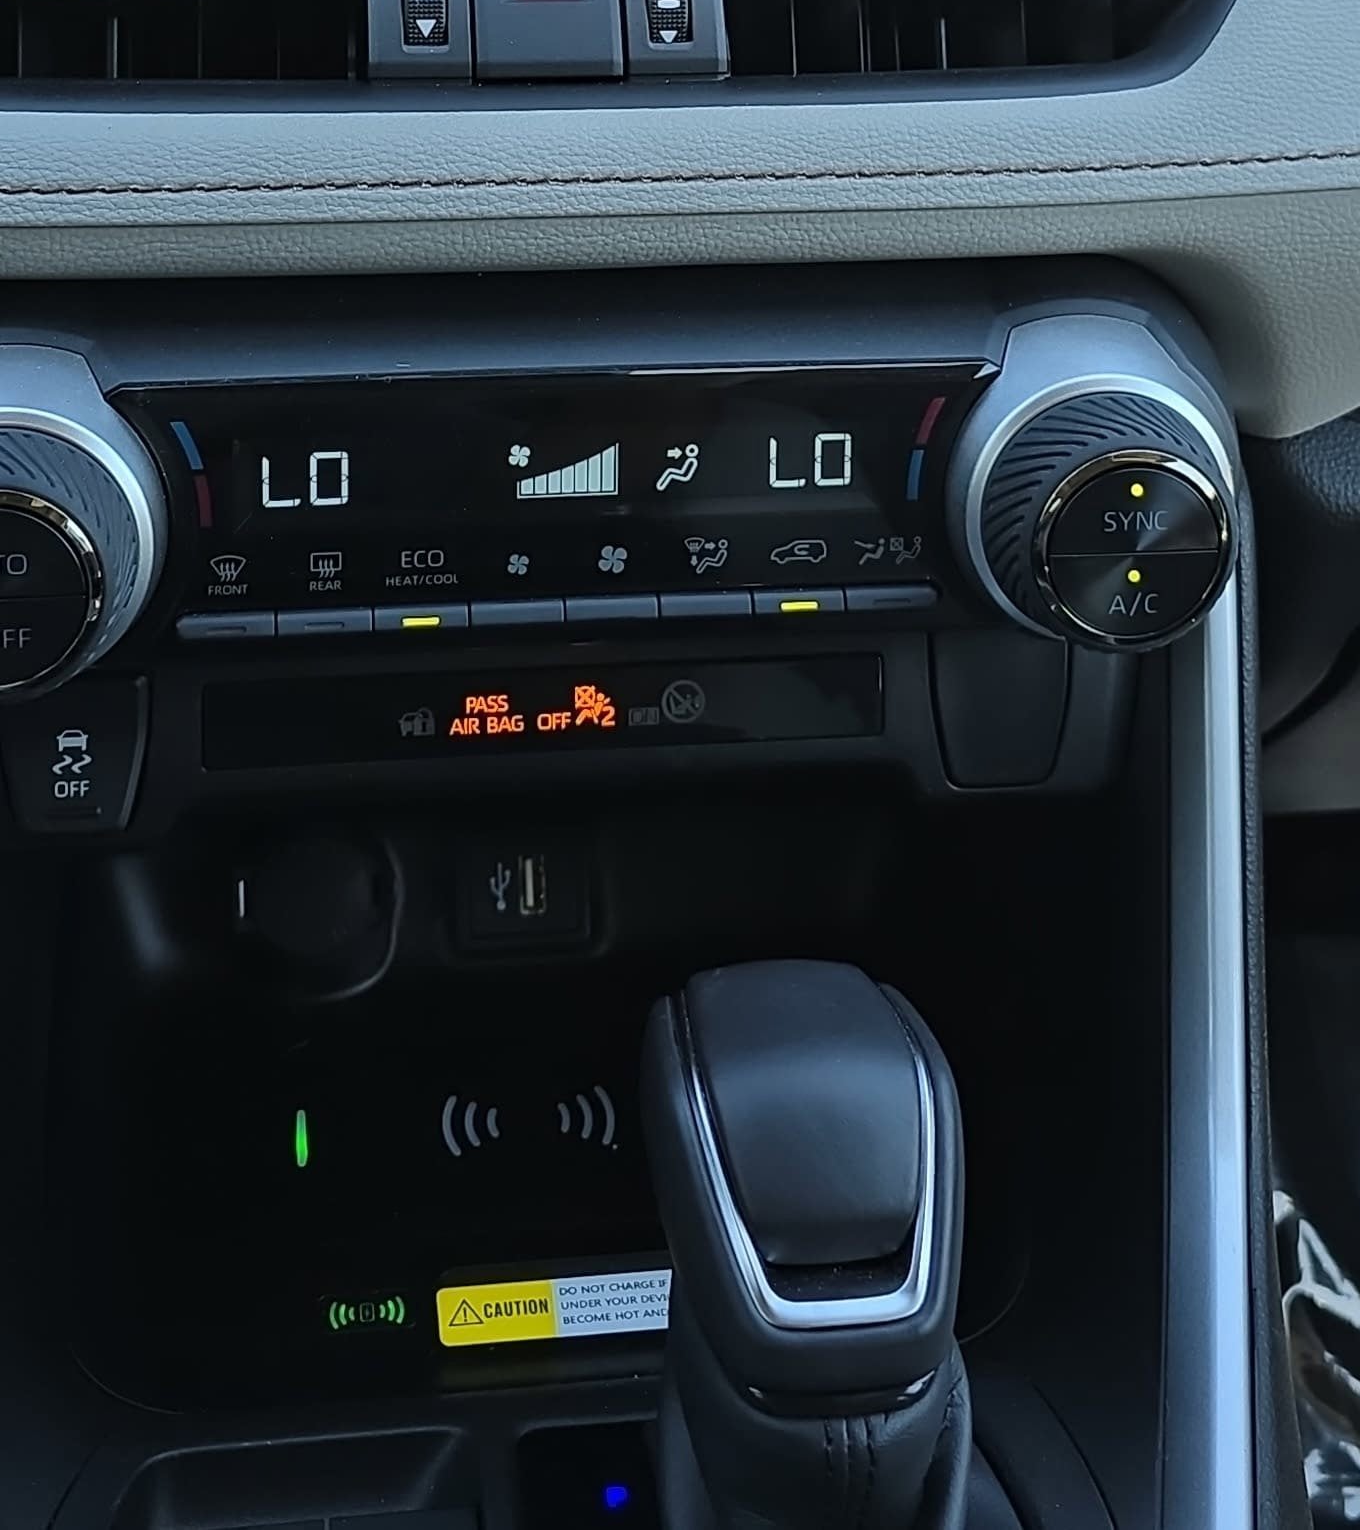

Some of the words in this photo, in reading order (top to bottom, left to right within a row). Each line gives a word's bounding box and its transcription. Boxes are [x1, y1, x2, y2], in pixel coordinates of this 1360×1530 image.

[1103, 509, 1169, 533] SYNC
[401, 549, 445, 568] ECO
[208, 583, 249, 596] FRONT
[309, 580, 342, 592] REAR
[385, 573, 459, 587] HEAT/COOL
[1108, 591, 1159, 618] A/C
[465, 694, 509, 714] PASS
[449, 717, 481, 736] AIR
[486, 714, 525, 734] BAG
[536, 711, 572, 731] OFF
[53, 780, 91, 799] OFF
[559, 1285, 578, 1297] DO
[581, 1282, 607, 1295] NOT
[608, 1278, 656, 1293] CHARGE
[658, 1278, 669, 1288] IF
[483, 1297, 550, 1320] CAUTION
[560, 1298, 603, 1311] UNDER
[605, 1295, 639, 1307] YOUR
[640, 1292, 671, 1305] DEVI
[563, 1311, 612, 1326] BECOME
[614, 1309, 640, 1321] HOT
